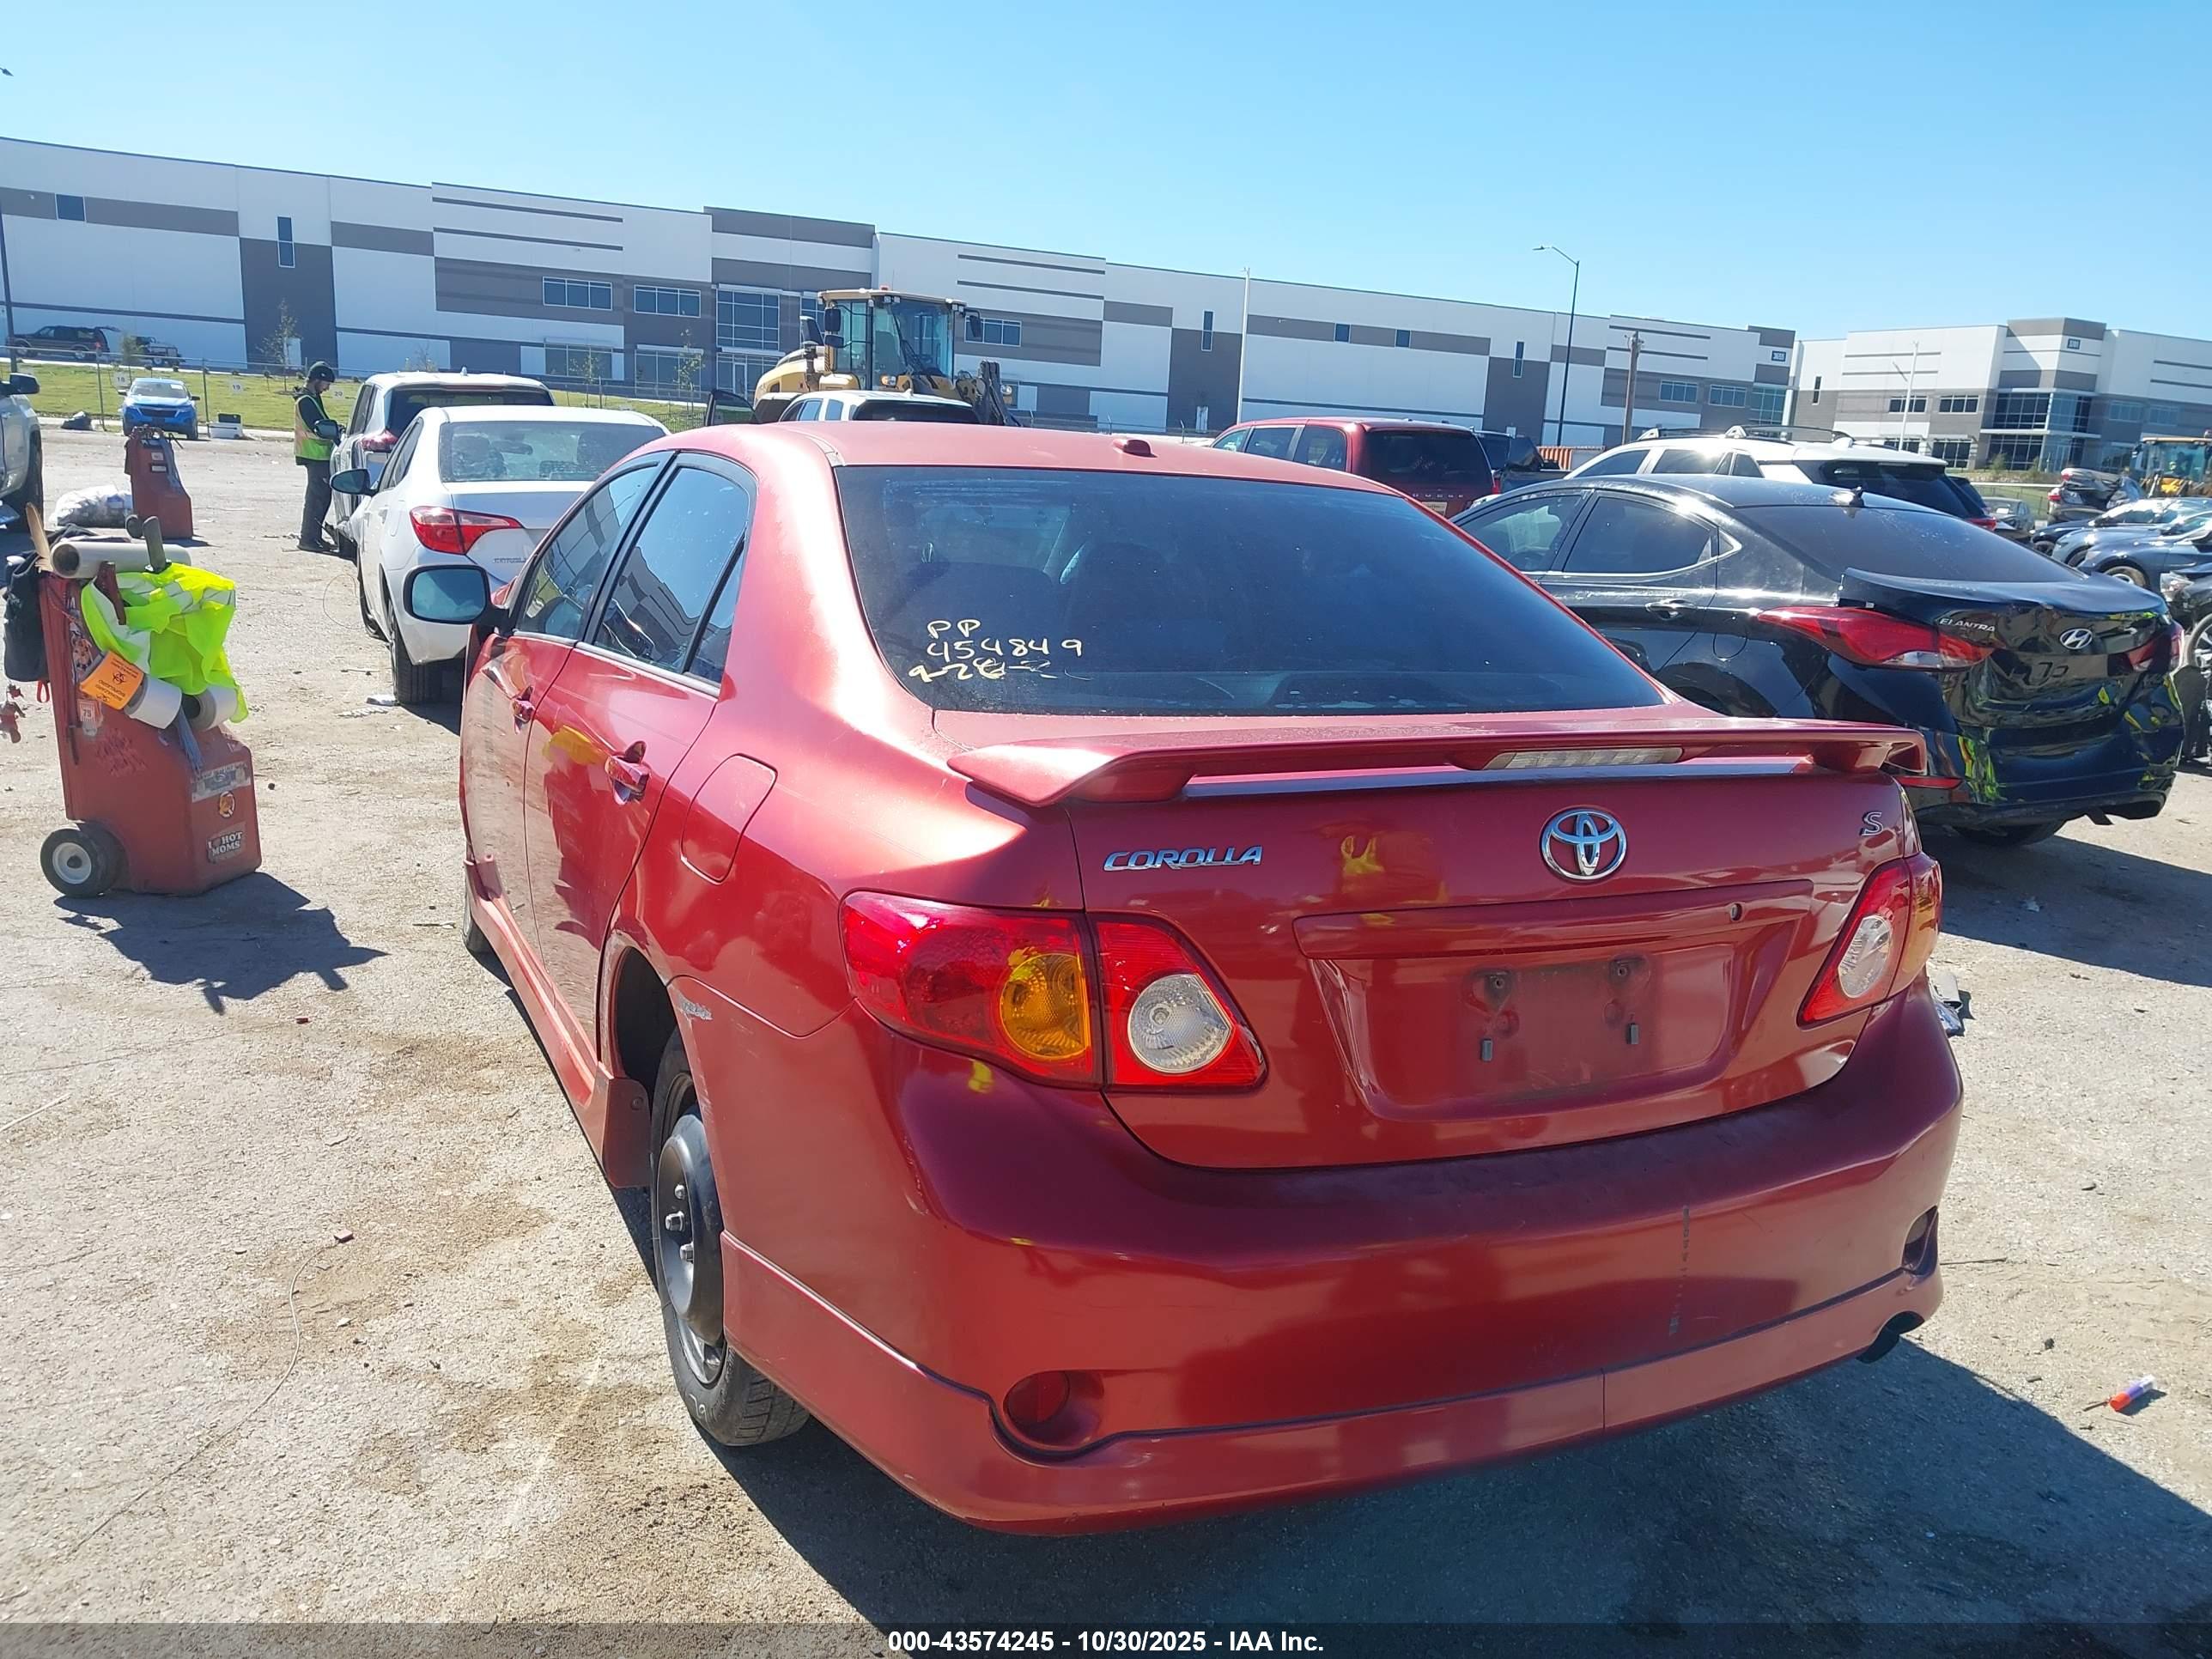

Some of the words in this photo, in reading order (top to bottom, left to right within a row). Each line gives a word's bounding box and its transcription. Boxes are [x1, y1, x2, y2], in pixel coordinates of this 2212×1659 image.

[1939, 617, 1996, 632] ELANTRA
[1860, 811, 1883, 836] S
[222, 831, 242, 844] HOT
[212, 841, 241, 857] MOMS
[1103, 846, 1262, 872] COROLLA
